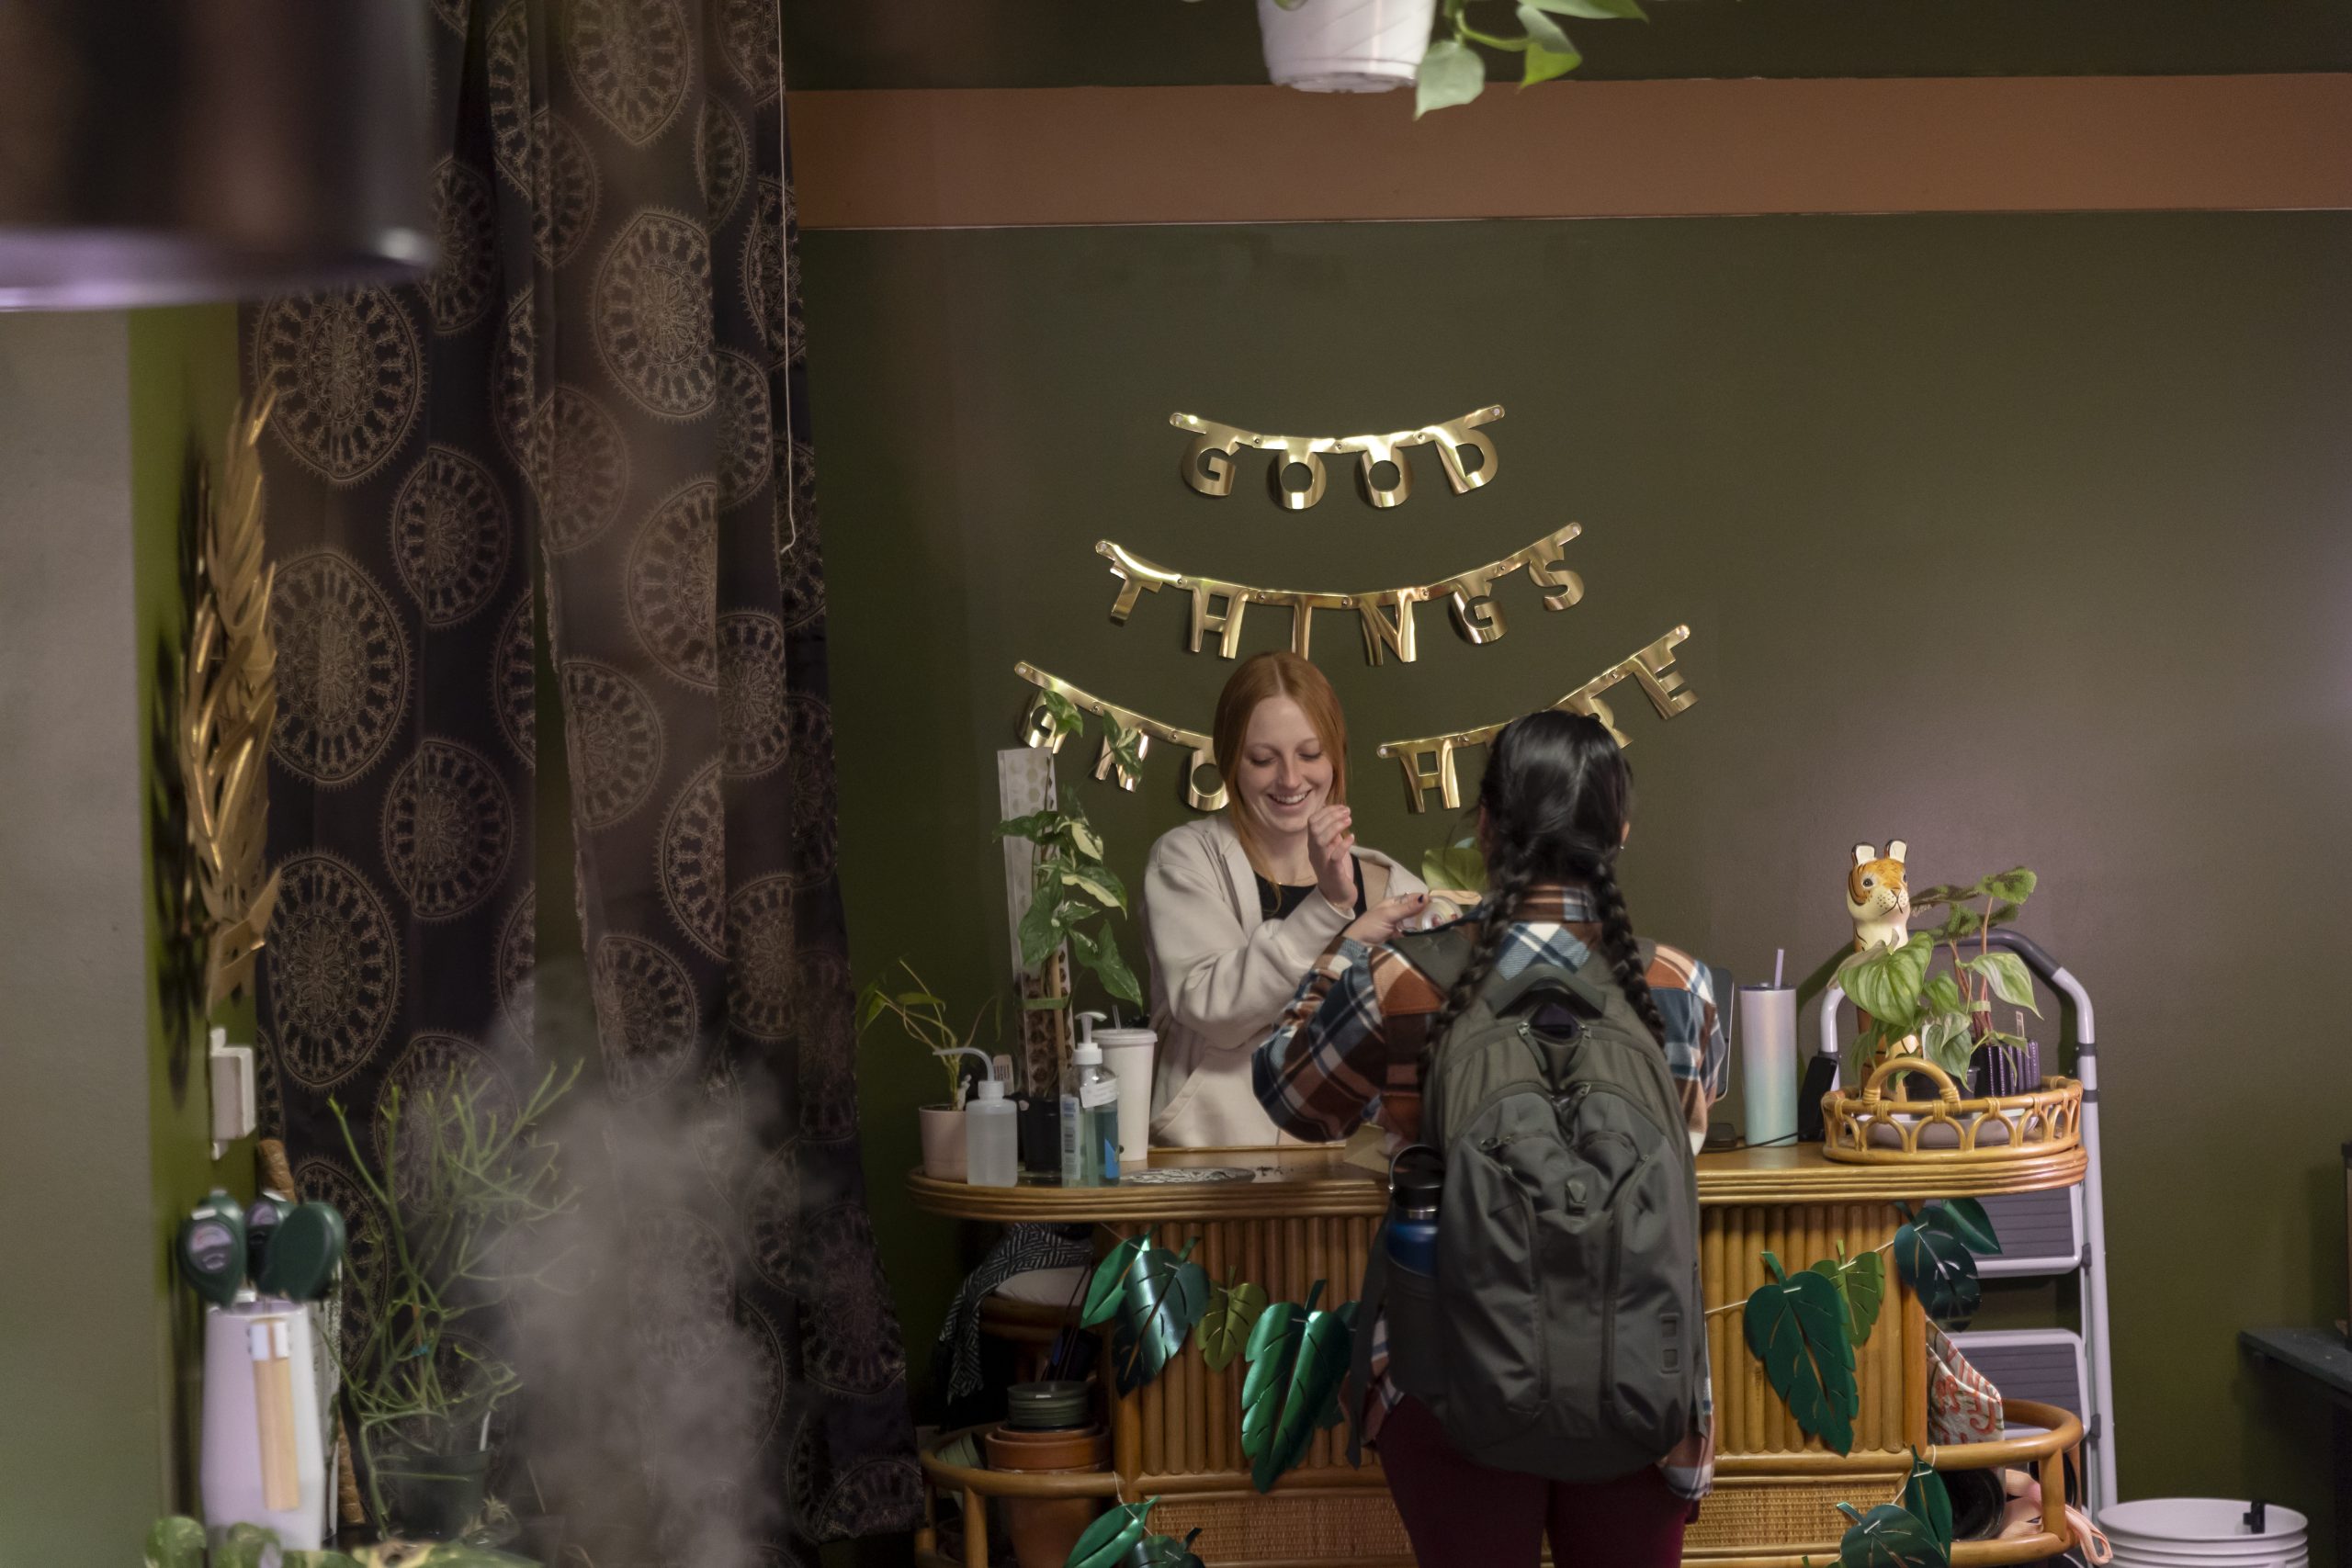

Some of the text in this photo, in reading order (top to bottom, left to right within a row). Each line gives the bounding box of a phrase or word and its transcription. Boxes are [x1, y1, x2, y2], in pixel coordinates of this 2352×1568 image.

[1172, 406, 1504, 511] GOOD
[1098, 523, 1585, 666] THINGS
[1015, 625, 1698, 813] GRO HRE
